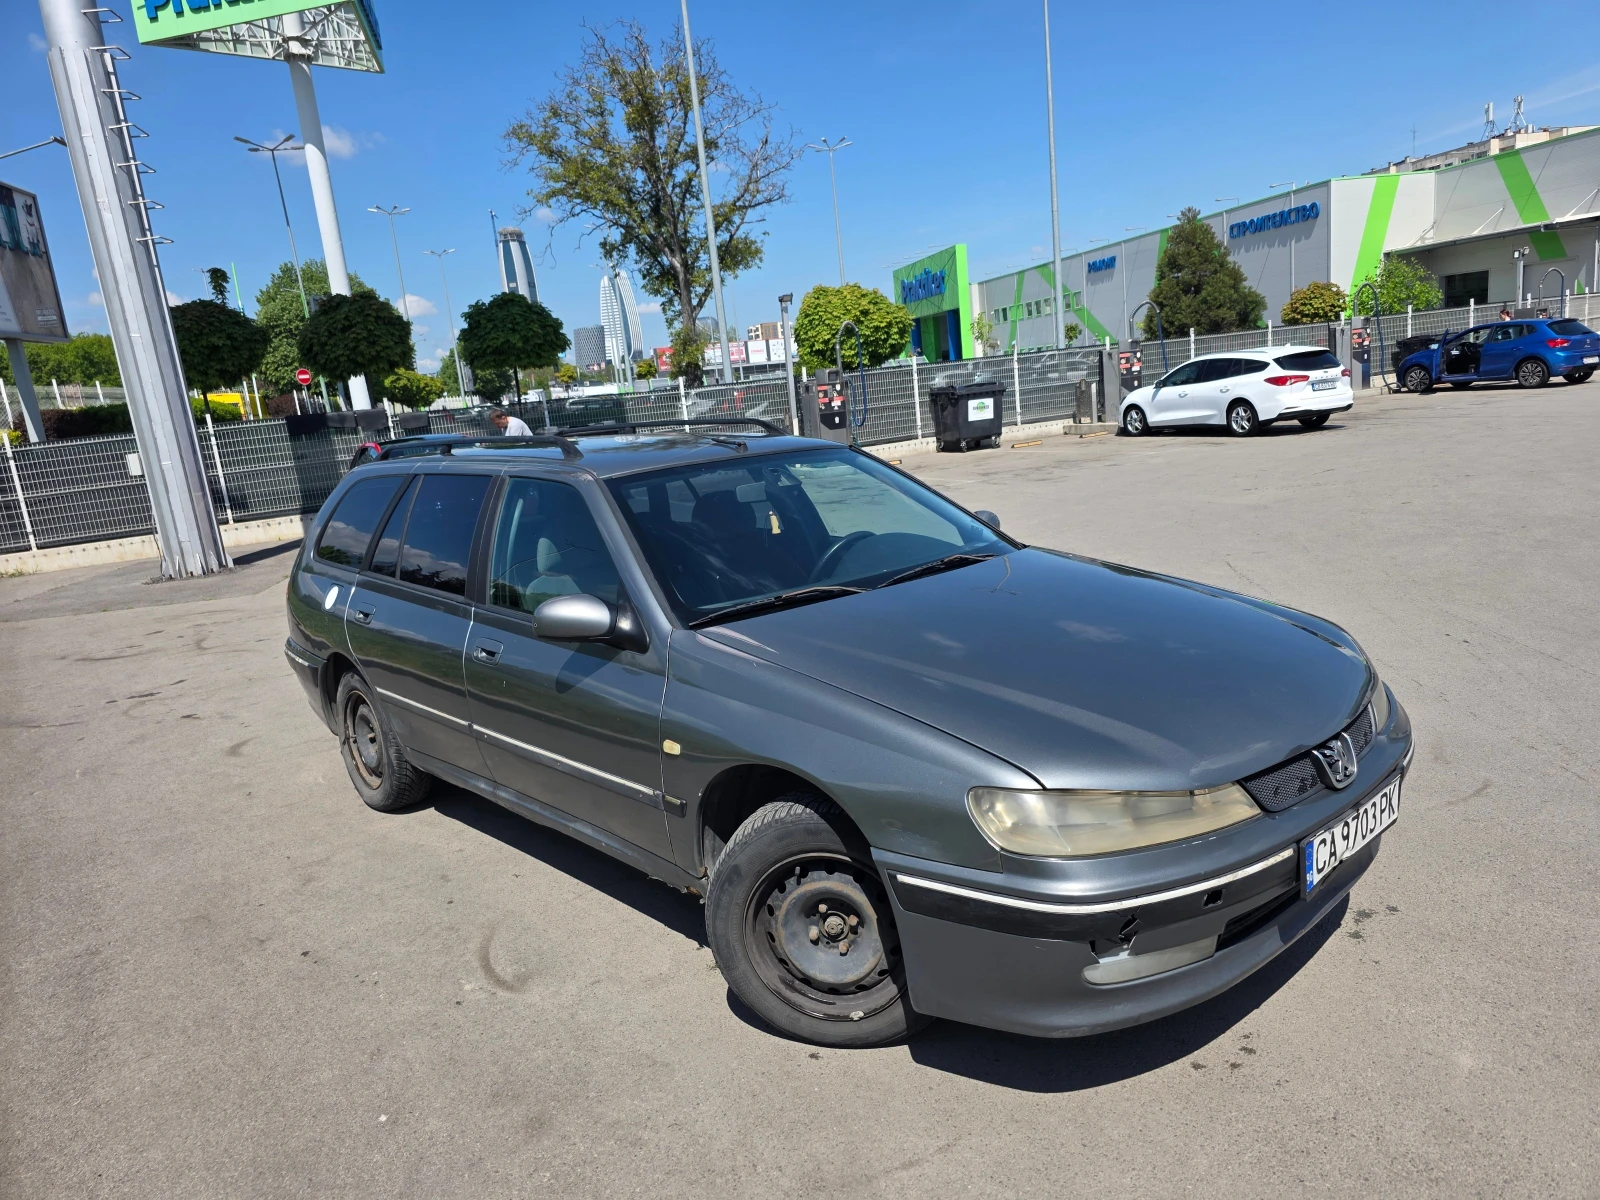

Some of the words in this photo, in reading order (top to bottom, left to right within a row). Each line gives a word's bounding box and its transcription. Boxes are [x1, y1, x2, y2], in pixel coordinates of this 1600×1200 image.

[1229, 201, 1320, 239] СТРОИТЕЛСТВО
[901, 268, 946, 304] Praktiker
[1316, 830, 1337, 874] CA
[1341, 801, 1377, 852] 9703
[1380, 783, 1397, 827] PK
